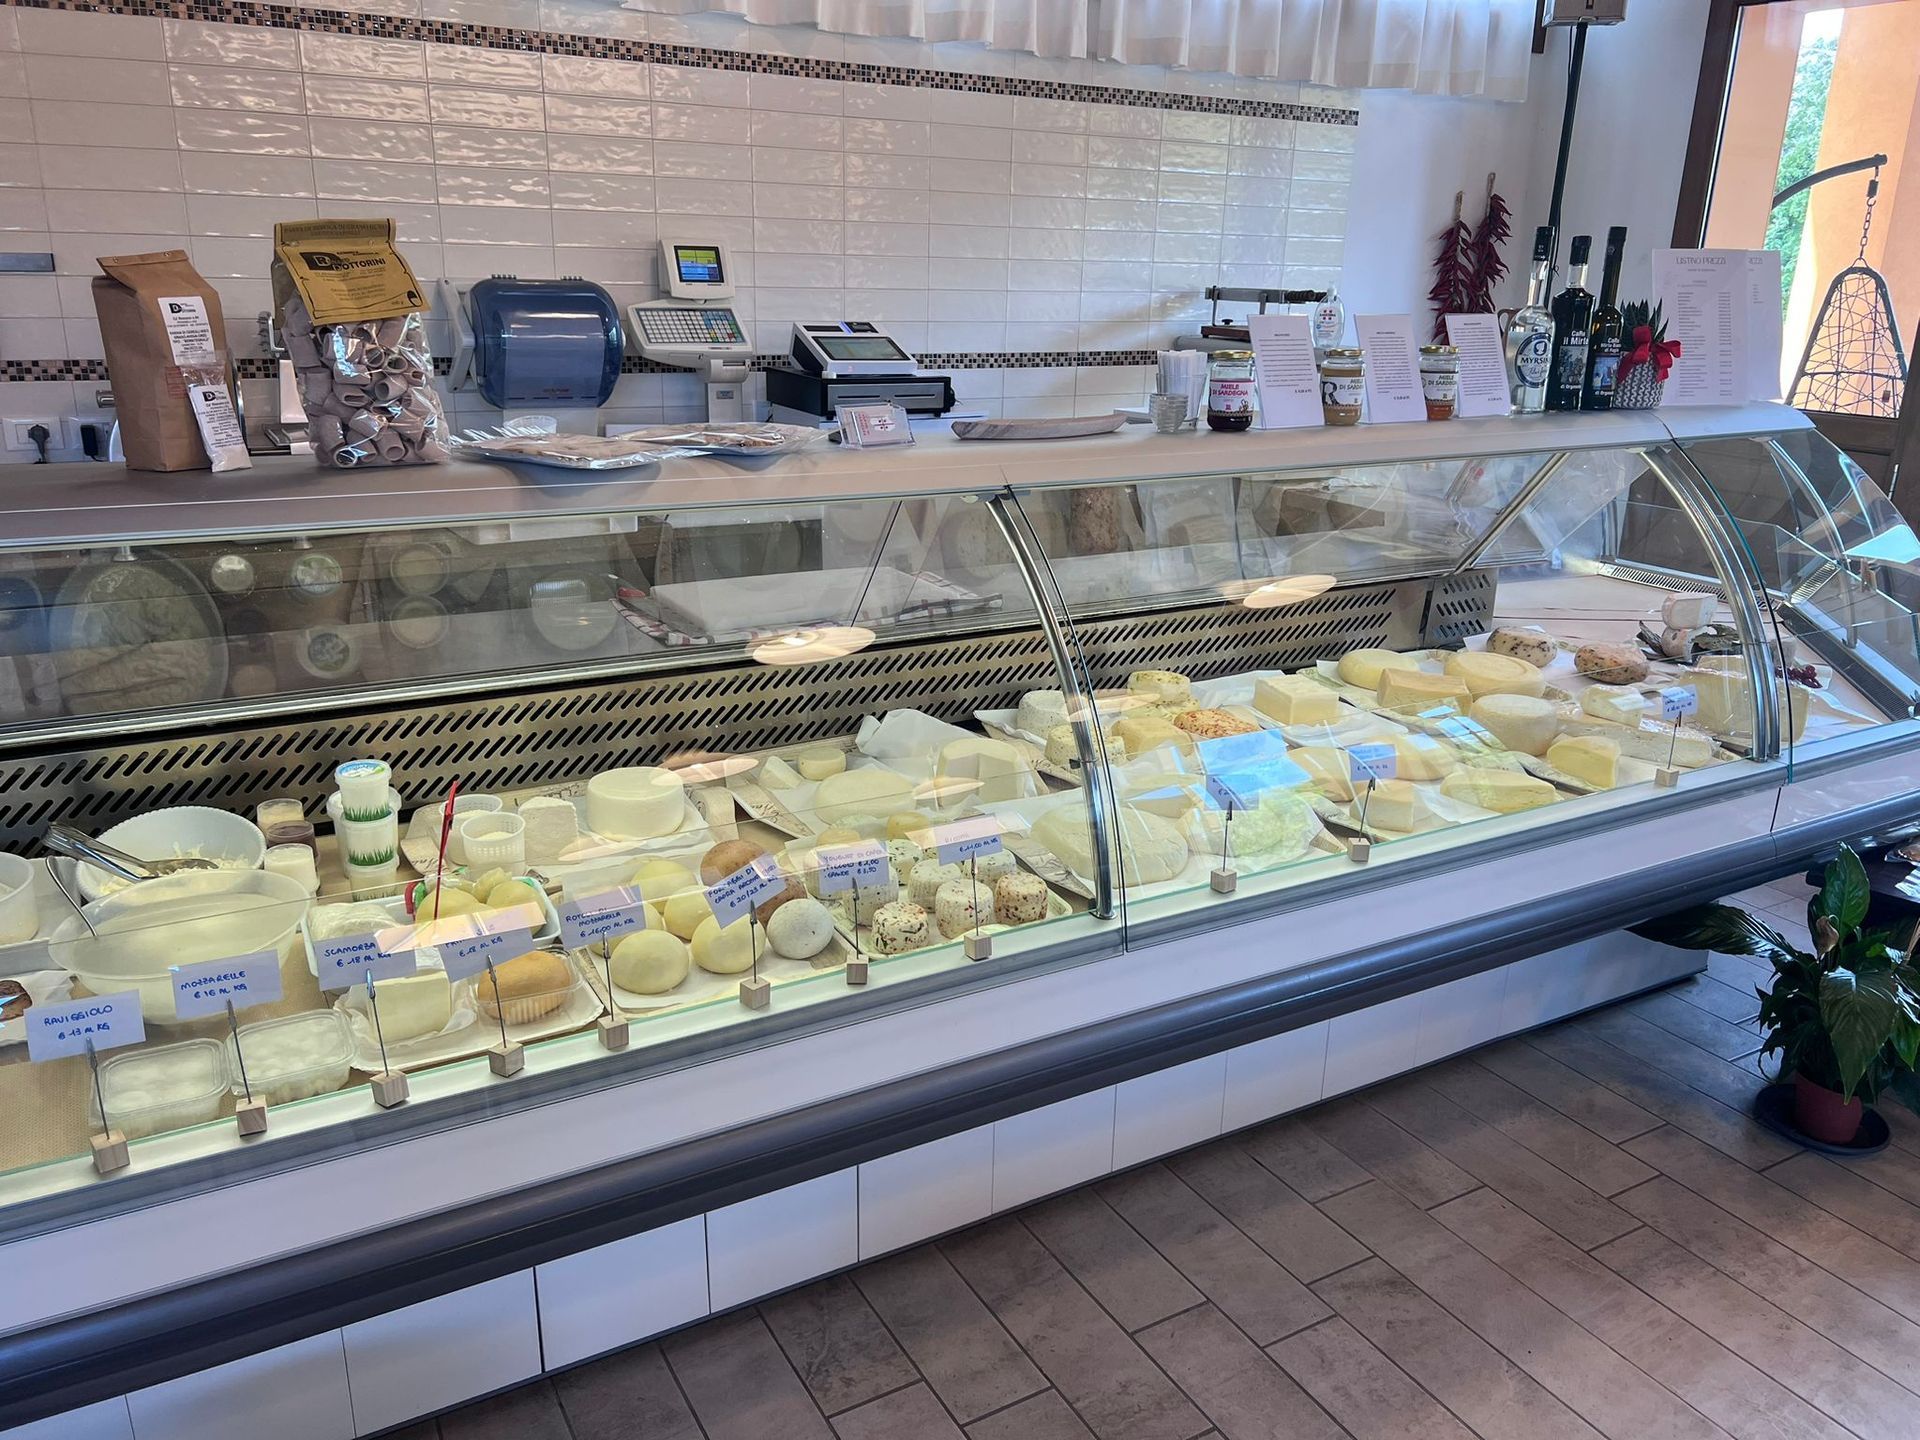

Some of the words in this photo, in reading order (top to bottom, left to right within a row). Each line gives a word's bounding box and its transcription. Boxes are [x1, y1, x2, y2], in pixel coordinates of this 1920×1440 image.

[1676, 257, 1702, 265] LISTINO
[1702, 257, 1727, 265] PREZZI
[714, 889, 736, 904] CAPRA
[737, 886, 759, 903] 20/25
[579, 930, 586, 938] €
[613, 921, 623, 929] AL
[623, 917, 636, 925] KG
[336, 958, 345, 968] €
[363, 954, 375, 963] AL
[193, 991, 202, 1000] €
[219, 986, 231, 995] AL
[233, 983, 248, 993] KG
[43, 1004, 114, 1026] RAVIGGIOLO
[57, 1030, 66, 1041] €
[68, 1028, 82, 1038] 13
[83, 1026, 96, 1035] AL
[97, 1022, 111, 1032] KG
